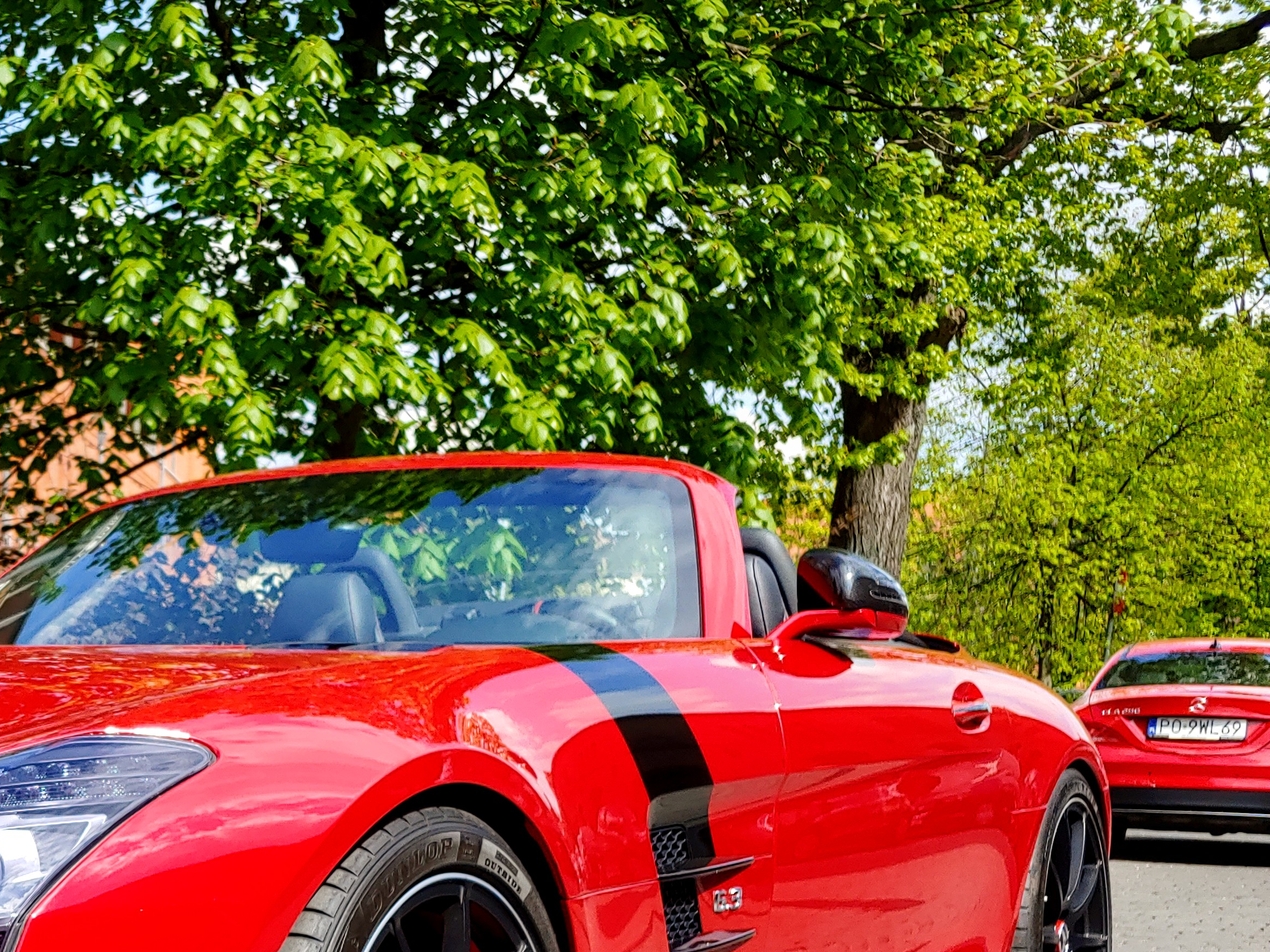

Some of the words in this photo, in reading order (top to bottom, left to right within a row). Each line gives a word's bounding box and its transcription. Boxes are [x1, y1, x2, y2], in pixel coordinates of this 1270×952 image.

[1160, 718, 1182, 735] PO
[1188, 719, 1241, 736] 9WL69
[369, 837, 454, 923] DUNLOP
[484, 857, 522, 895] OUTSIDE
